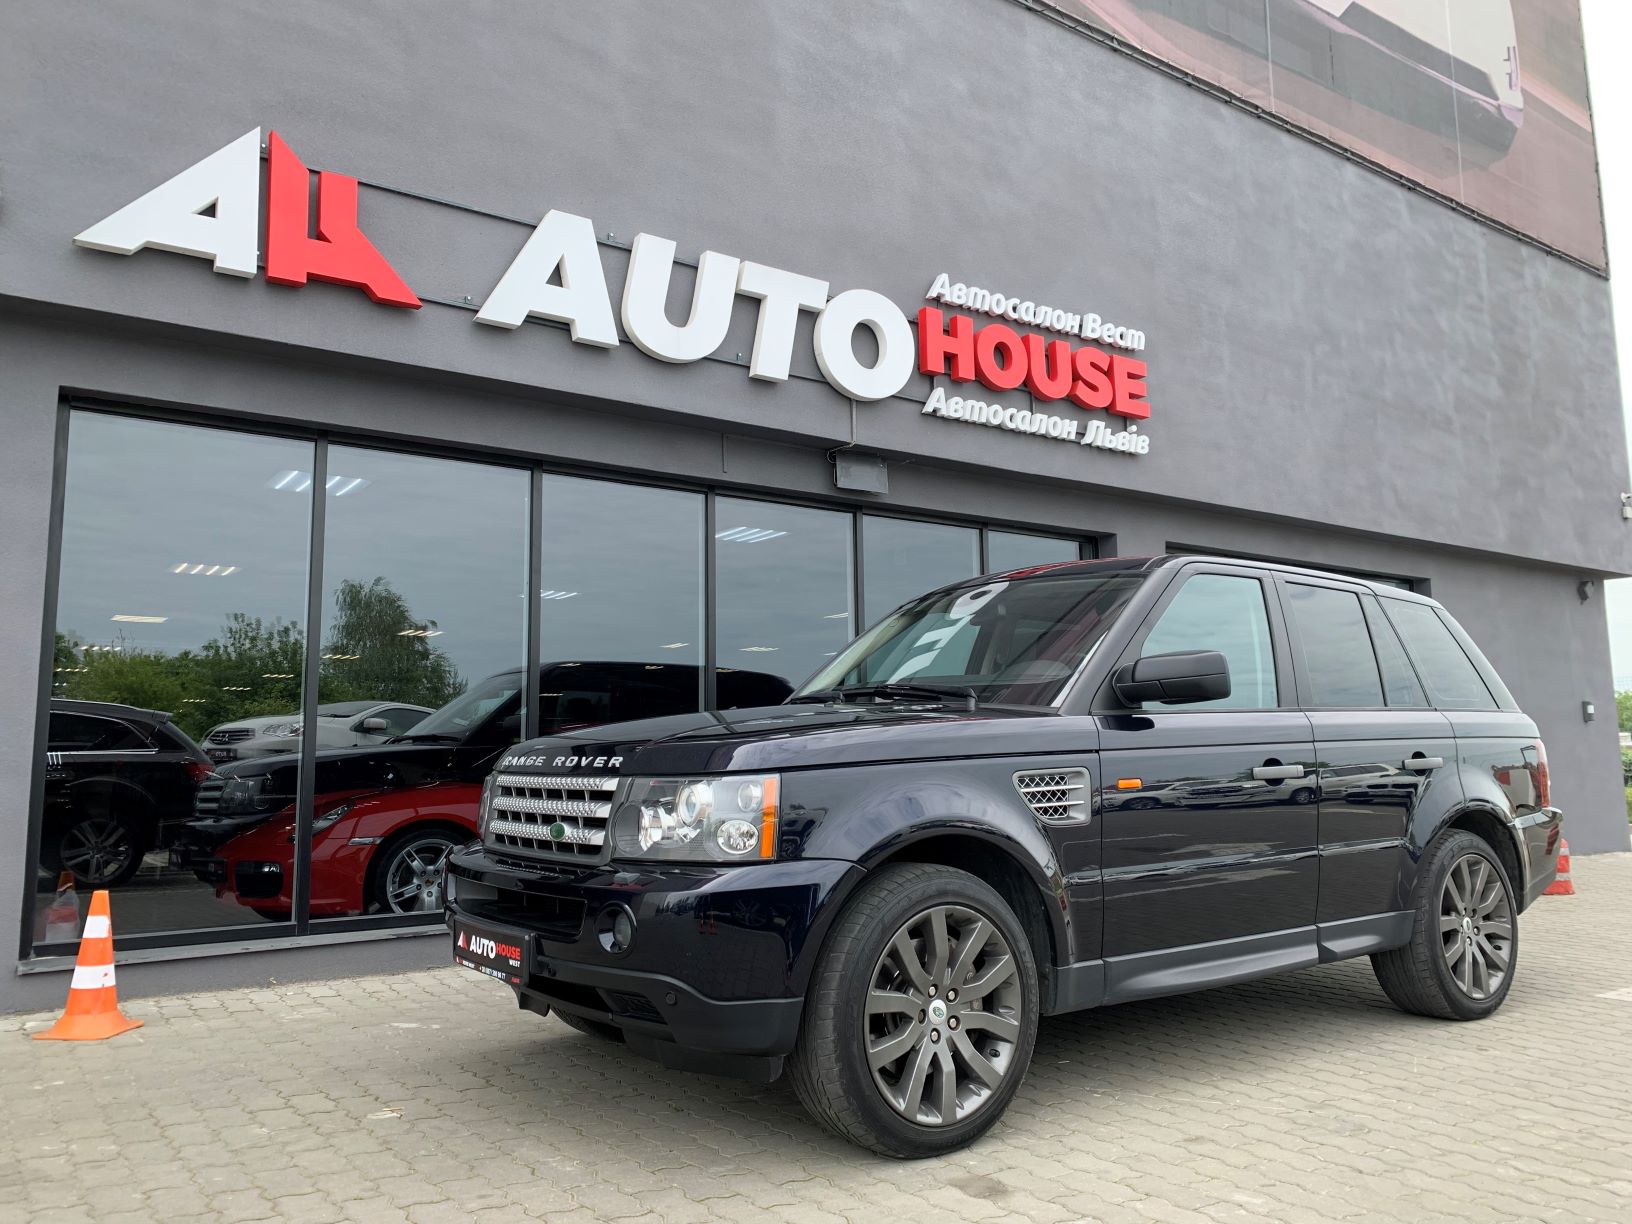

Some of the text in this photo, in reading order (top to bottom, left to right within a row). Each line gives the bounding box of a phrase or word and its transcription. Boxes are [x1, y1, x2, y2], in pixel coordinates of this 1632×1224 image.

[925, 272, 1146, 351] Автосалон Вест
[917, 306, 1151, 420] HOUSE
[921, 386, 1150, 455] Автосалон Львів
[501, 755, 624, 769] RANGE ROVER
[508, 958, 521, 968] WEST
